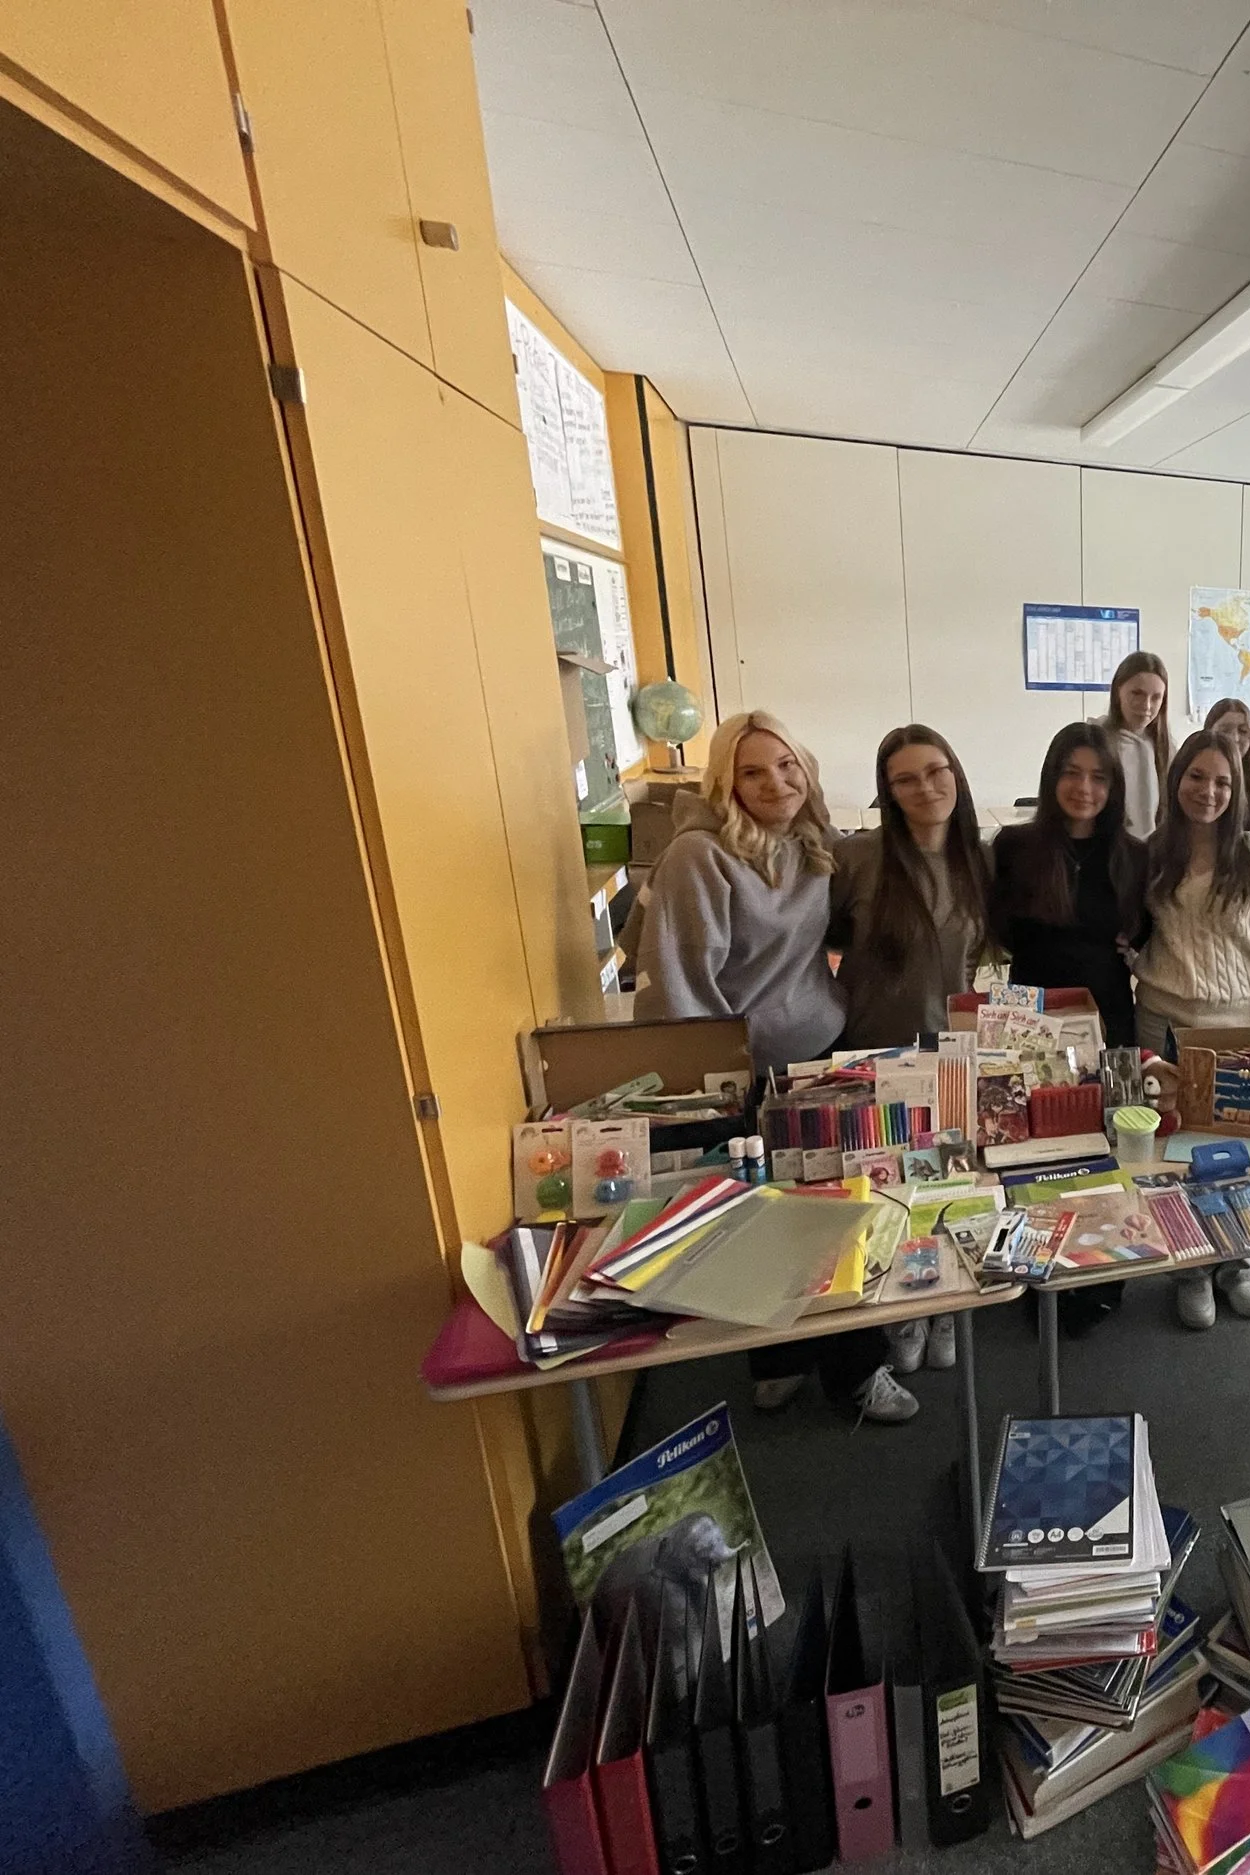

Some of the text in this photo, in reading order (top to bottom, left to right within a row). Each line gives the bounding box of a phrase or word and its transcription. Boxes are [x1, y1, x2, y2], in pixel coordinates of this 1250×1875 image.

[1035, 1170, 1078, 1183] Pelikan
[657, 1431, 705, 1469] Pelikan
[1049, 1530, 1062, 1539] A4
